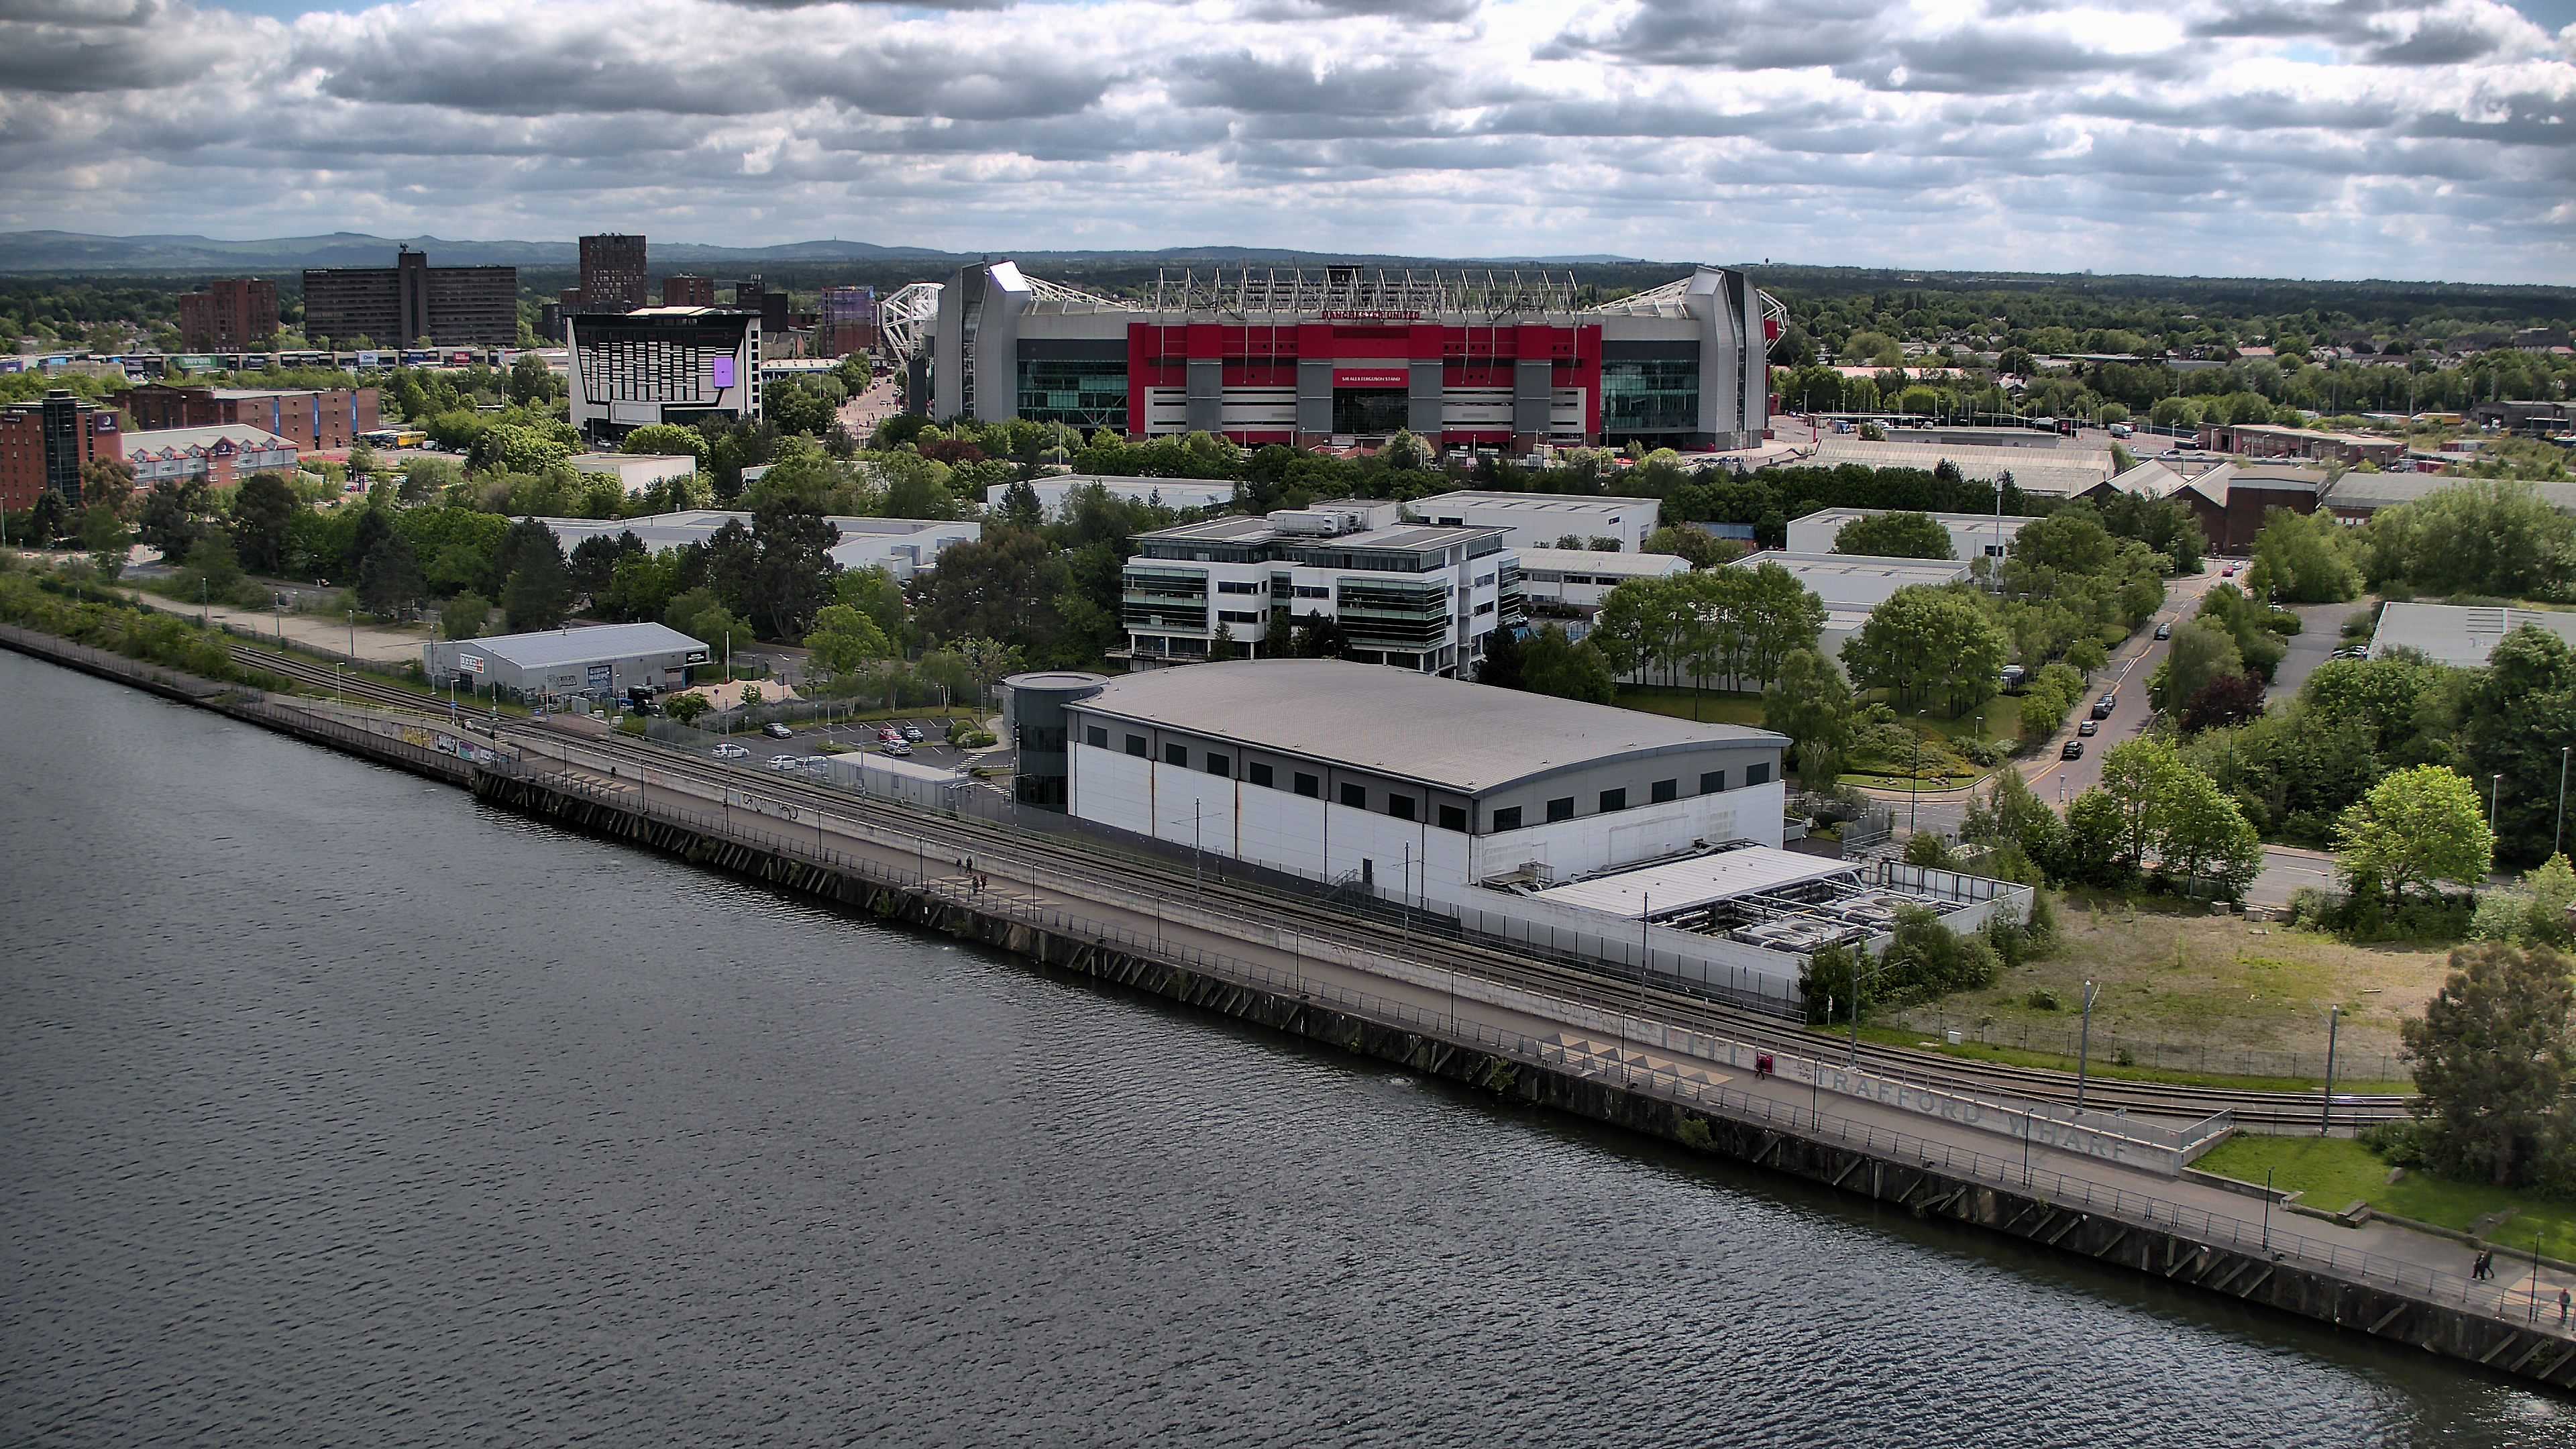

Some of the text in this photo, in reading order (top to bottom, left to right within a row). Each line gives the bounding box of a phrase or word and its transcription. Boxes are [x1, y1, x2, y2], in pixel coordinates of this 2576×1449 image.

[1322, 311, 1420, 319] MANCHESTER UNITED
[1816, 1067, 2129, 1159] TRAFFORD WHARF
